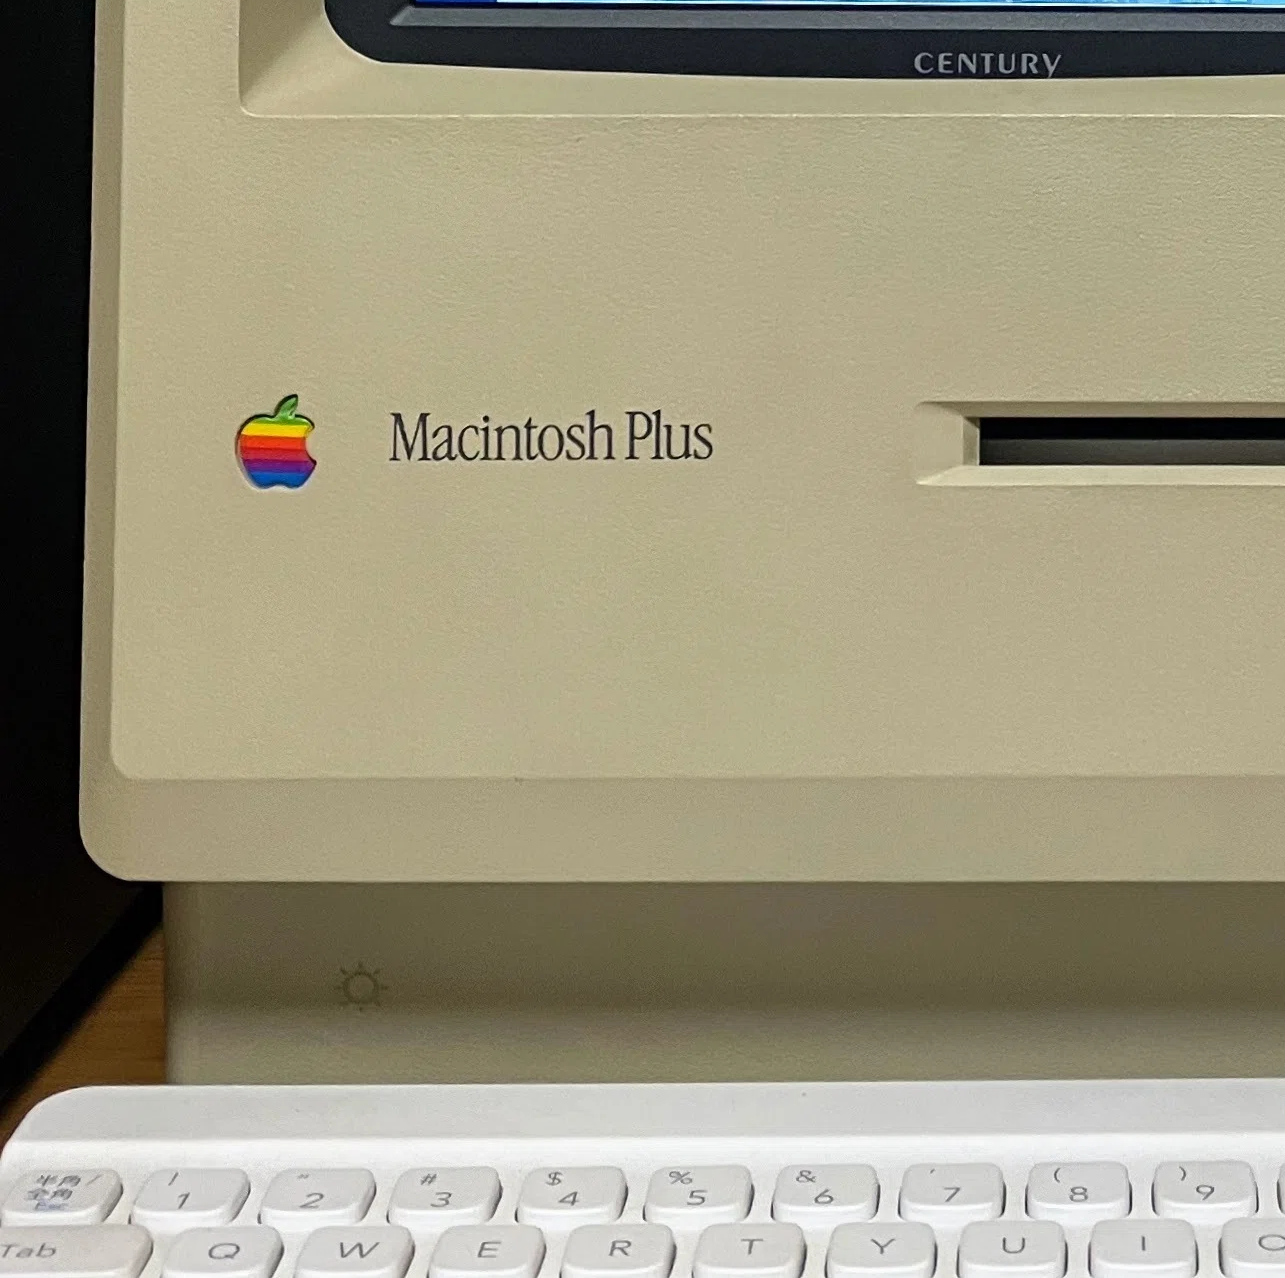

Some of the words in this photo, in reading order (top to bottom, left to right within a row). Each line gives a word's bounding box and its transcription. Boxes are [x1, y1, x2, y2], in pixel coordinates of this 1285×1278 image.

[914, 52, 1061, 78] CENTURY
[389, 409, 615, 462] Macintosh
[625, 409, 714, 461] Plus
[420, 1173, 436, 1185] #
[546, 1172, 562, 1185] $
[669, 1170, 693, 1184] %
[796, 1170, 816, 1183] &
[1053, 1168, 1061, 1183] (
[1180, 1167, 1187, 1181] )
[430, 1192, 452, 1207] 3
[559, 1191, 580, 1206] 4
[686, 1190, 707, 1205] 5
[814, 1188, 834, 1204] 6
[943, 1187, 960, 1202] 7
[1069, 1186, 1089, 1202] 8
[1196, 1184, 1215, 1200] 9
[177, 1192, 190, 1209] 1
[300, 1192, 324, 1209] 2
[208, 1243, 239, 1259] Q
[339, 1242, 380, 1258] W
[476, 1241, 502, 1258] E
[609, 1240, 632, 1256] R
[741, 1238, 764, 1254] T
[871, 1238, 895, 1254] Y
[1002, 1237, 1025, 1254] U
[1141, 1236, 1146, 1251] I
